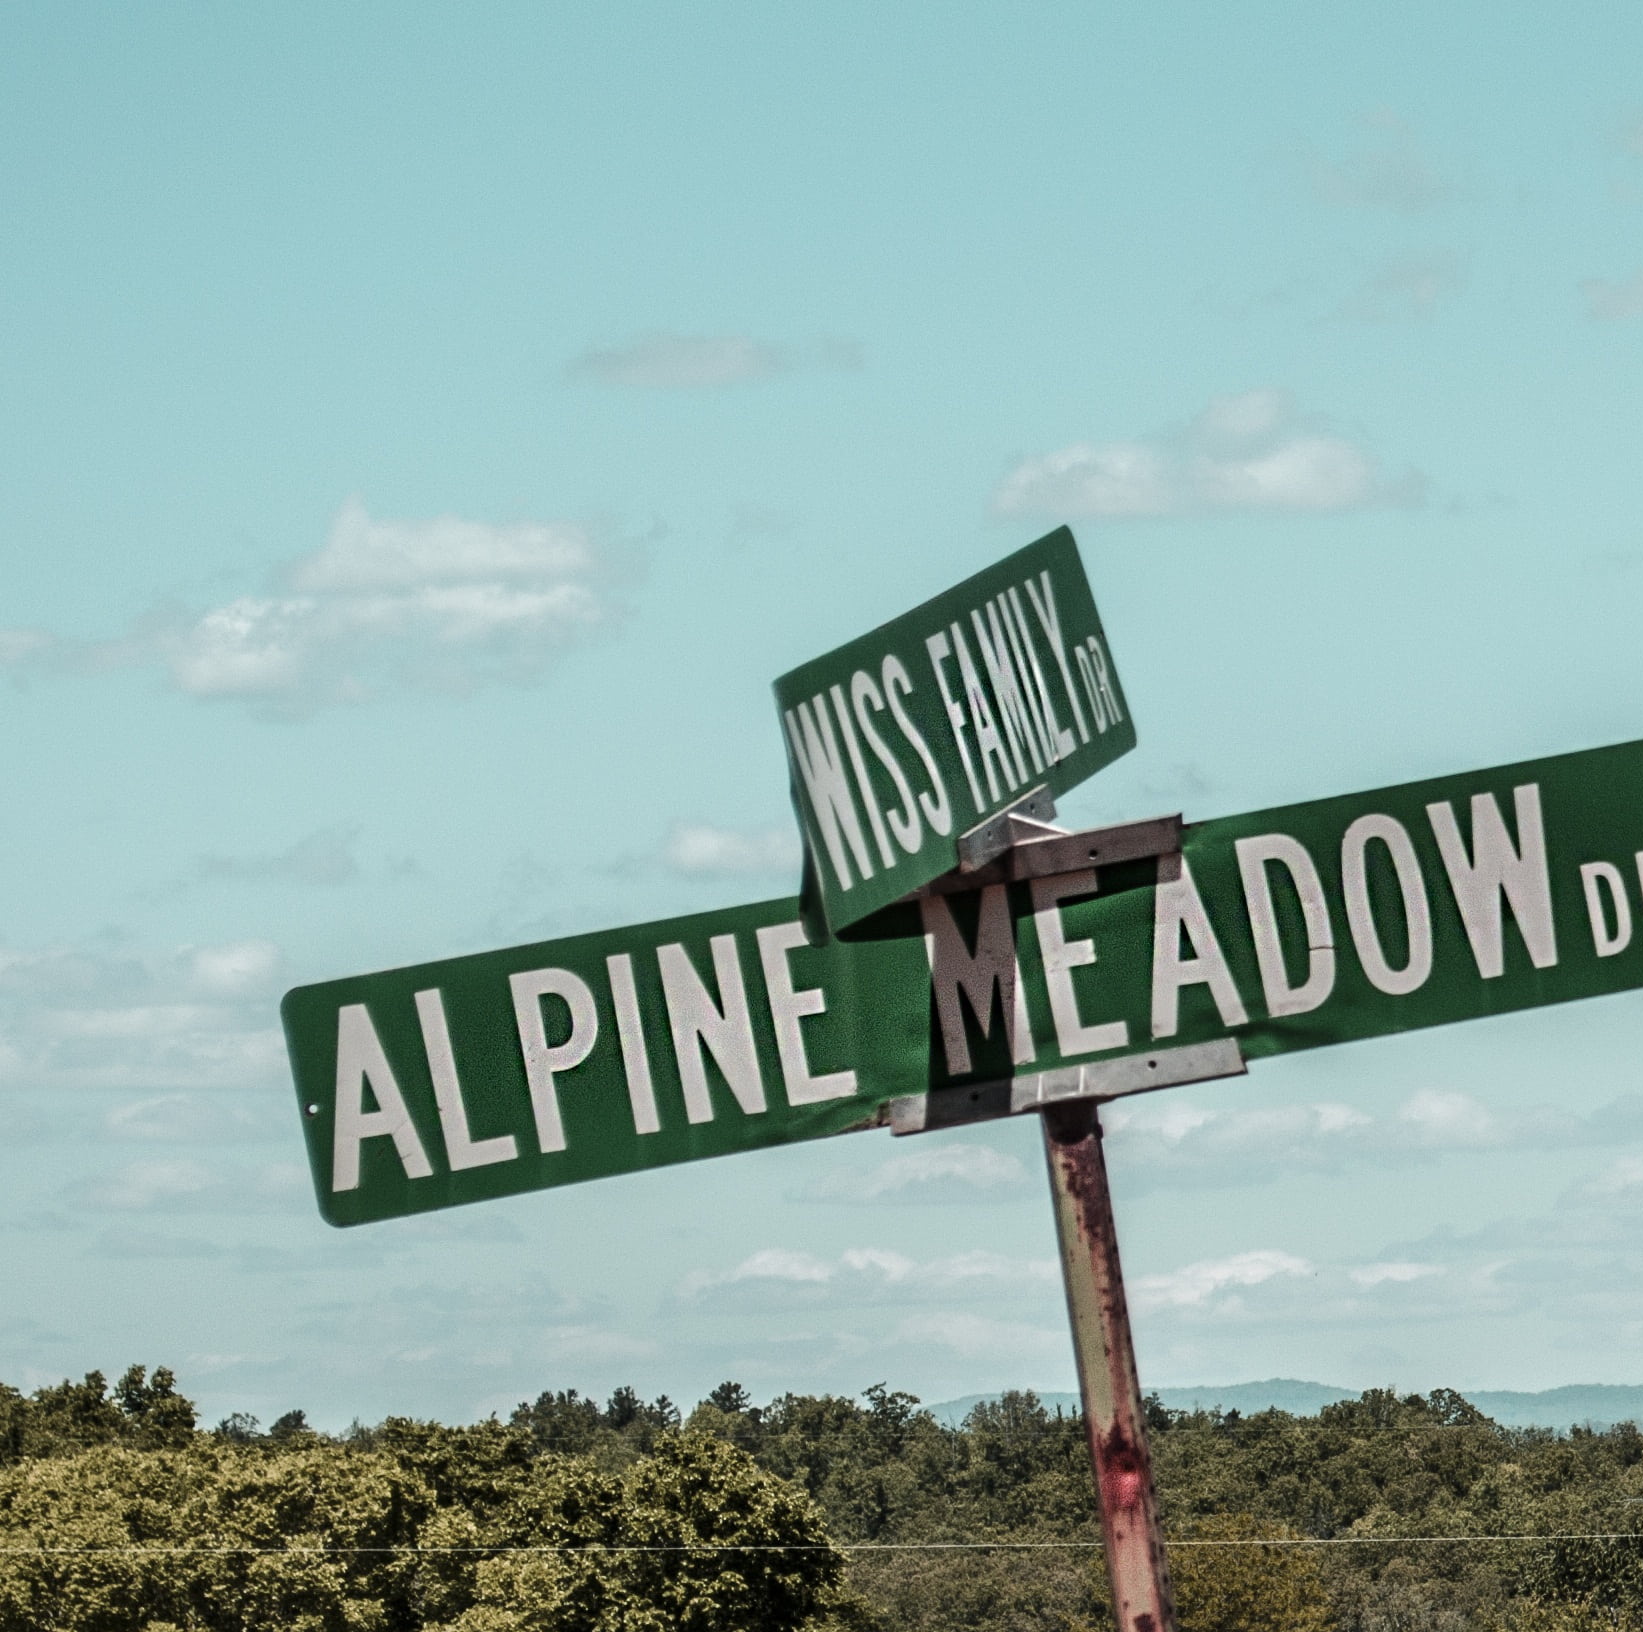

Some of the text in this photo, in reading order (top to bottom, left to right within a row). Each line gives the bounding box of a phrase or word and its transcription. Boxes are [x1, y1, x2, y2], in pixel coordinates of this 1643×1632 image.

[784, 569, 1124, 892] WISS FAMILY DR
[332, 919, 858, 1193] ALPINE
[918, 782, 1559, 1077] MEADOW
